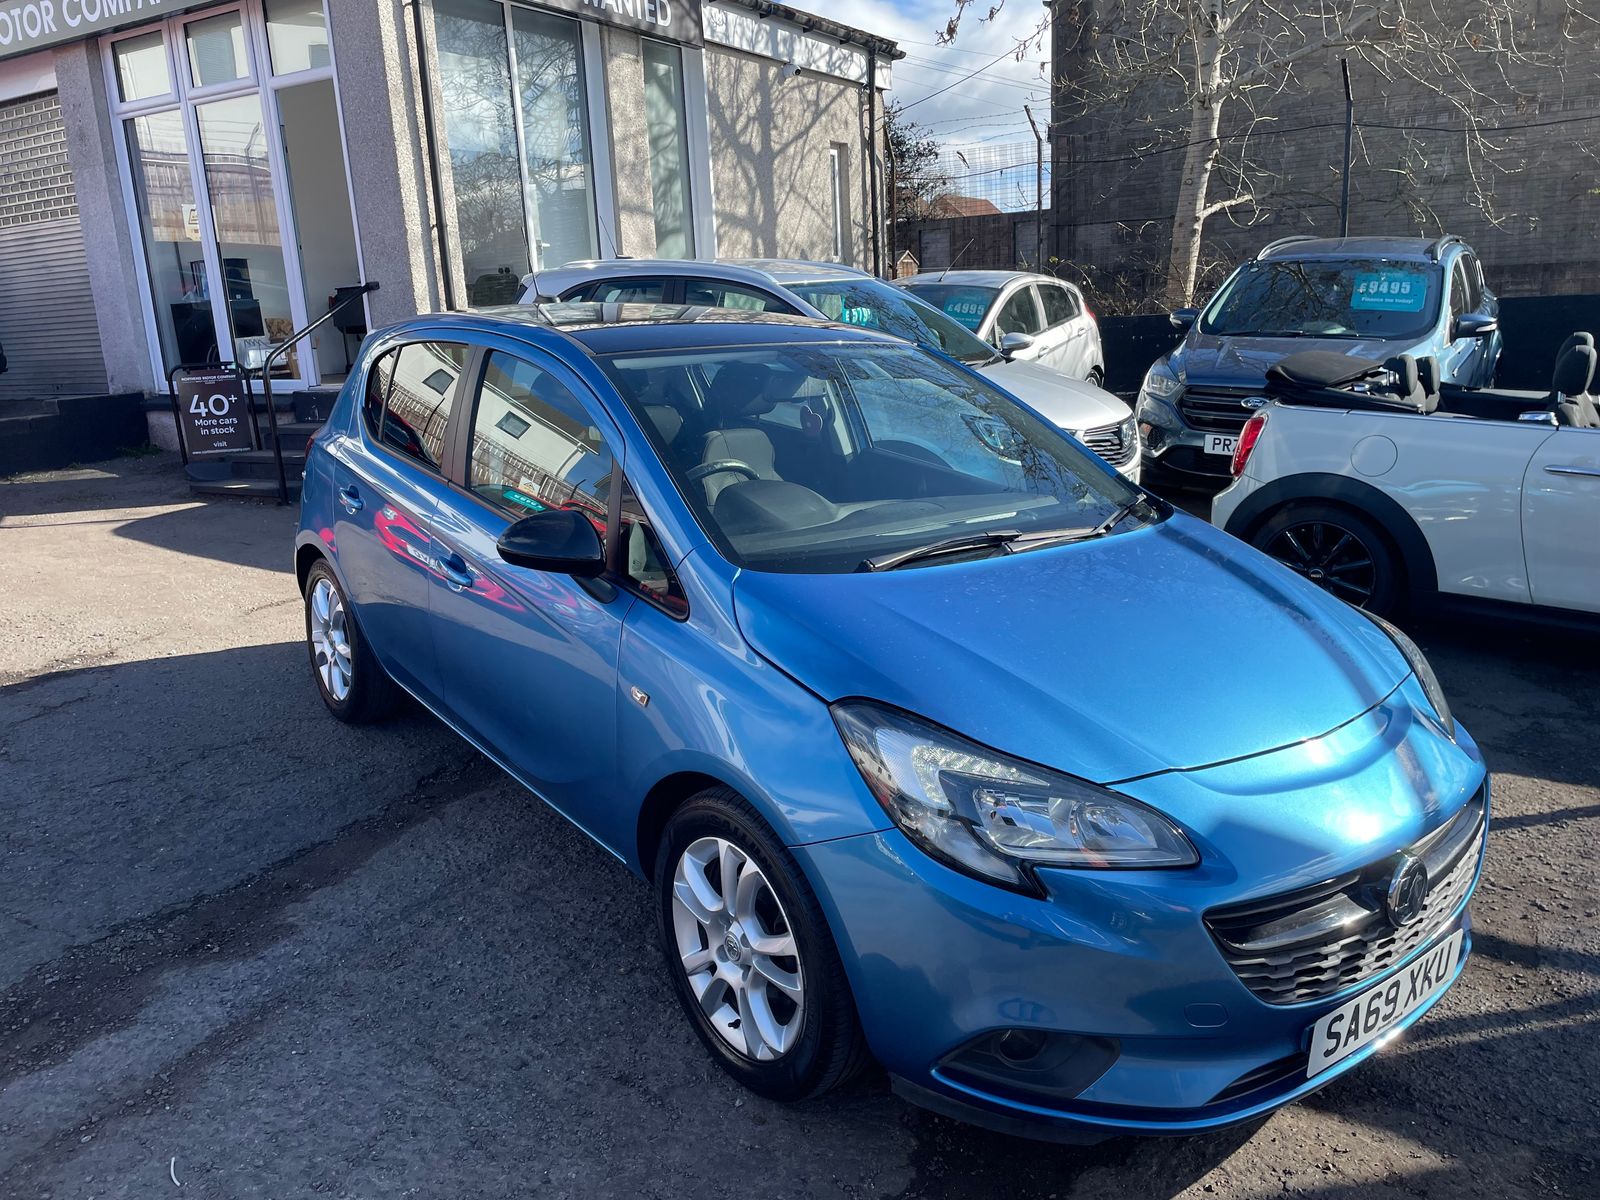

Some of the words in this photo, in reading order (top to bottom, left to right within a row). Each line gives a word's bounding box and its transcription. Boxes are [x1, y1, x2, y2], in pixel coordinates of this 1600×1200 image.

[947, 302, 986, 315] £4995
[189, 394, 238, 417] 40+
[194, 418, 218, 427] More
[218, 417, 238, 425] cars
[200, 427, 209, 436] in
[210, 425, 235, 435] stock
[1323, 979, 1401, 1058] SA69
[1403, 941, 1453, 1010] XKU
